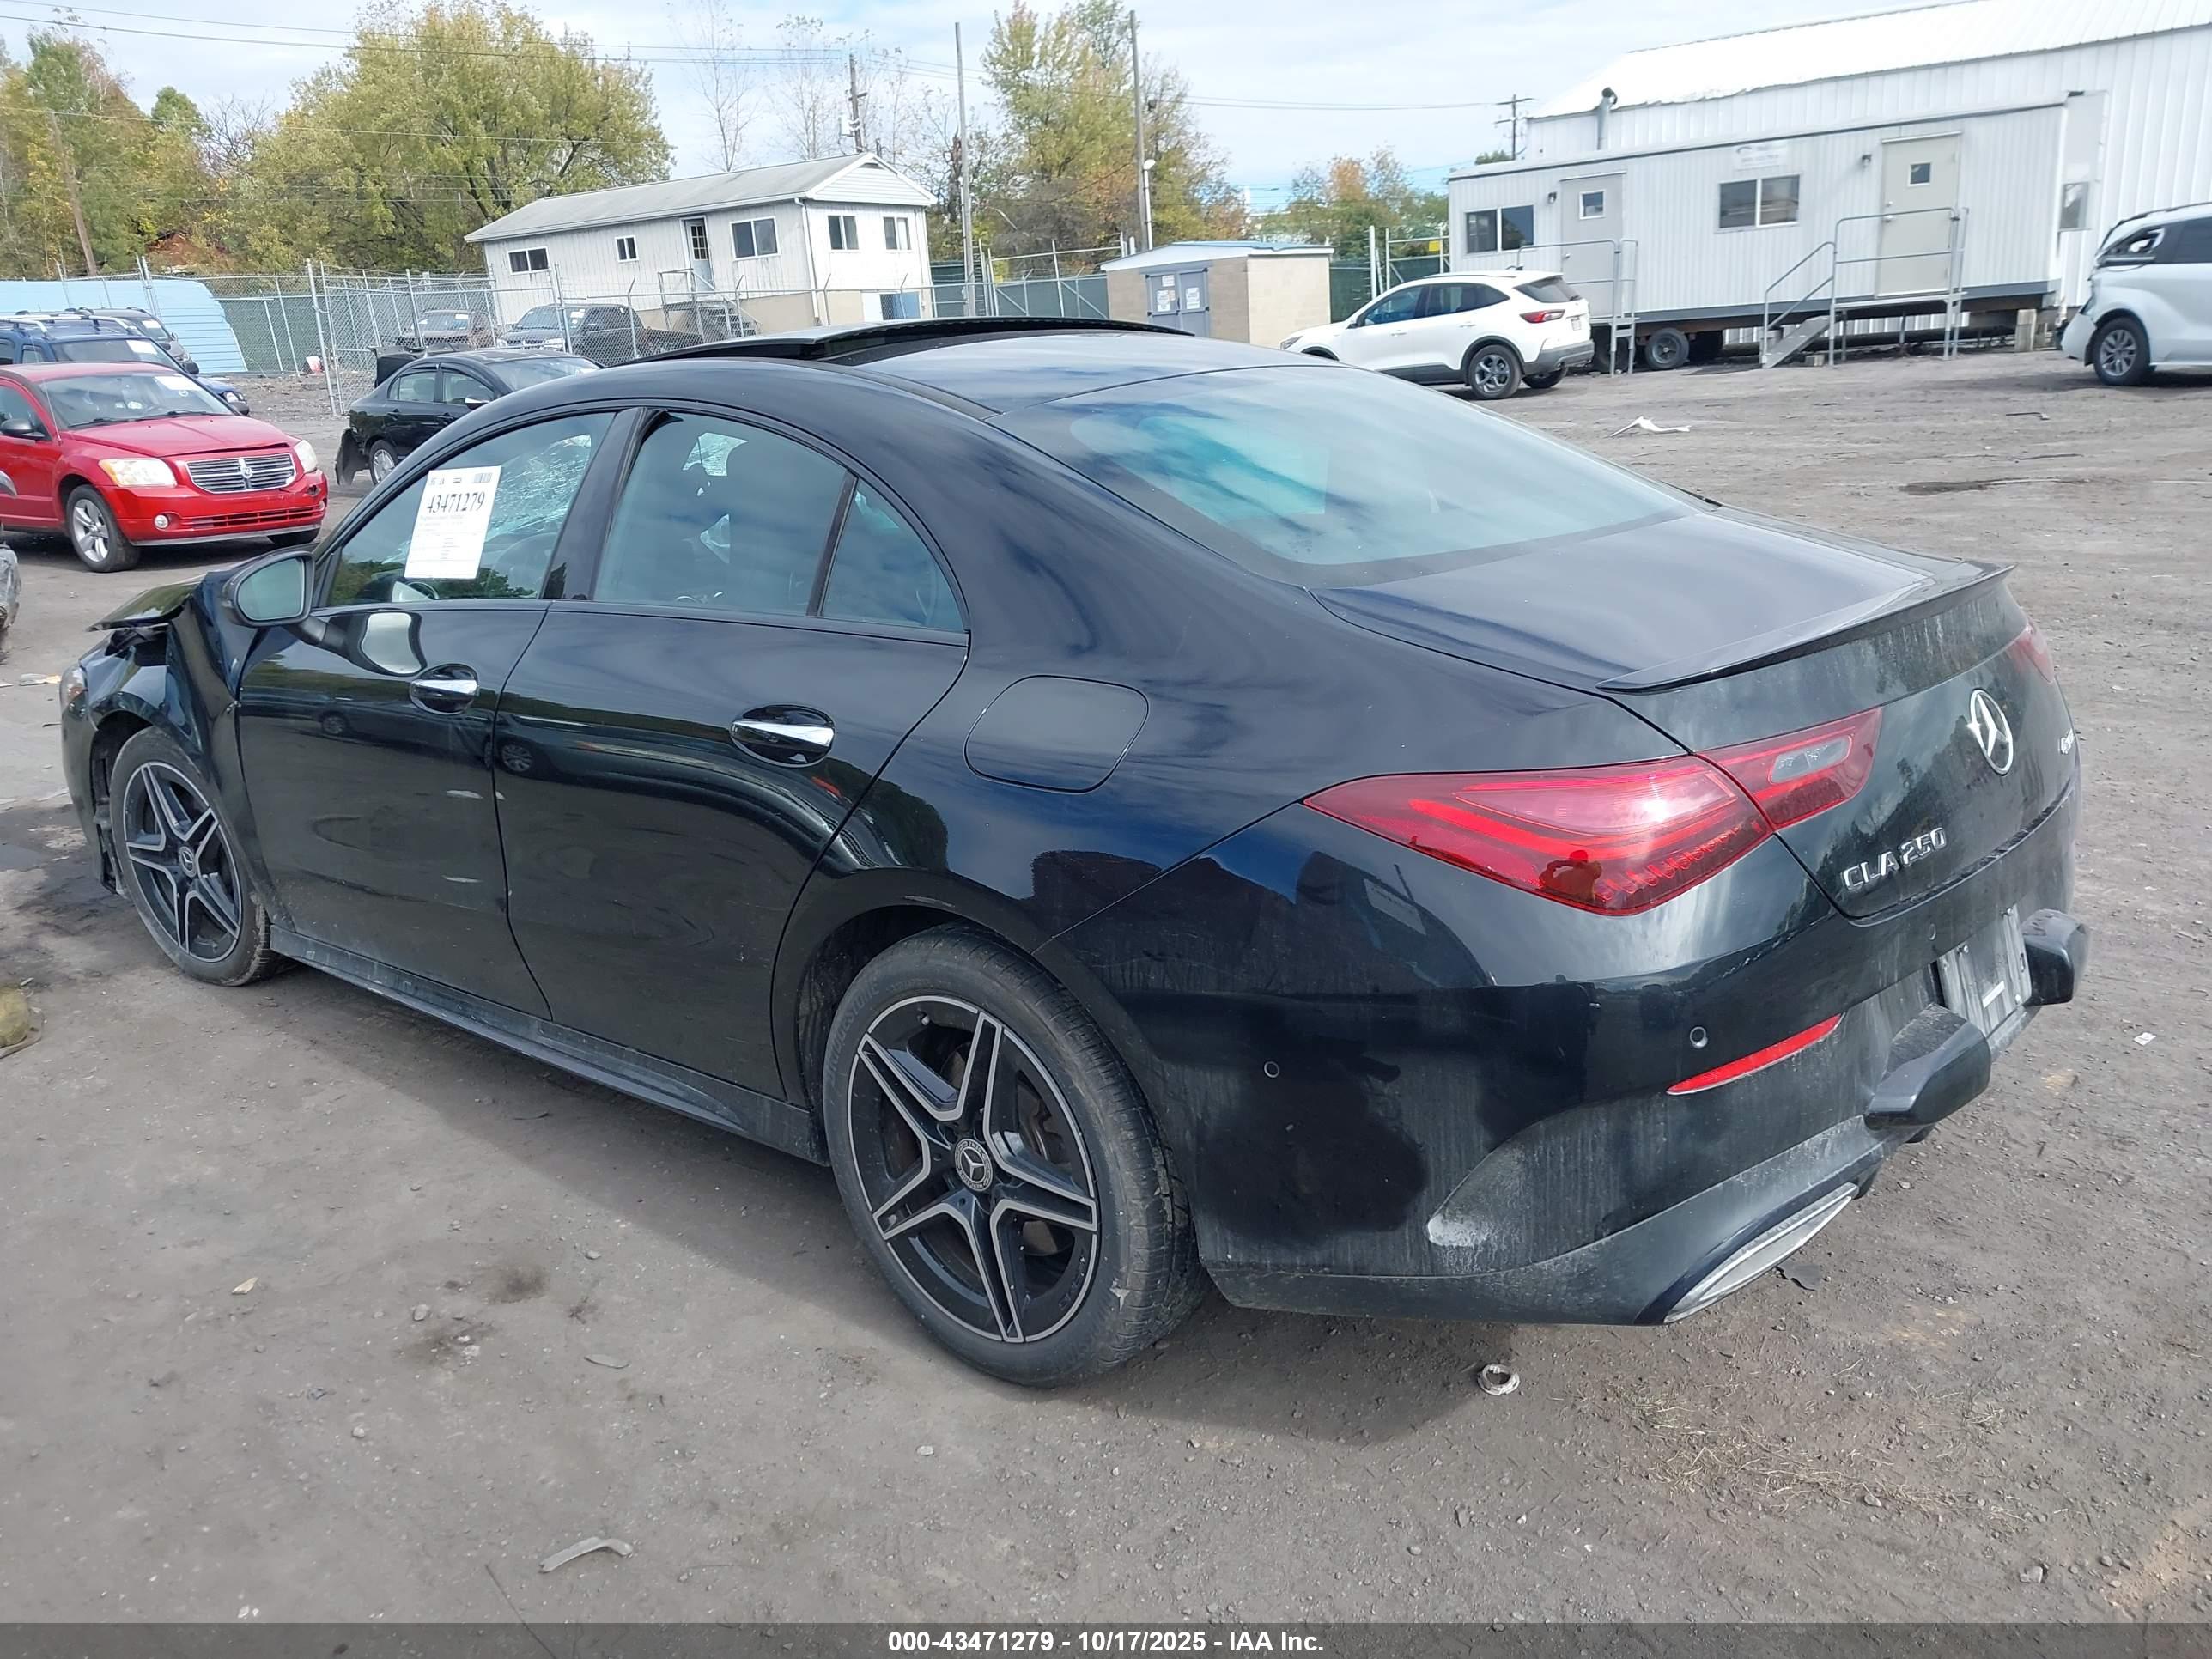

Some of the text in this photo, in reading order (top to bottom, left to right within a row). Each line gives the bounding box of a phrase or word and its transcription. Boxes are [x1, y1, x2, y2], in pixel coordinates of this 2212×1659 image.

[427, 491, 485, 514] 43471279
[1841, 827, 1947, 890] CLA 250
